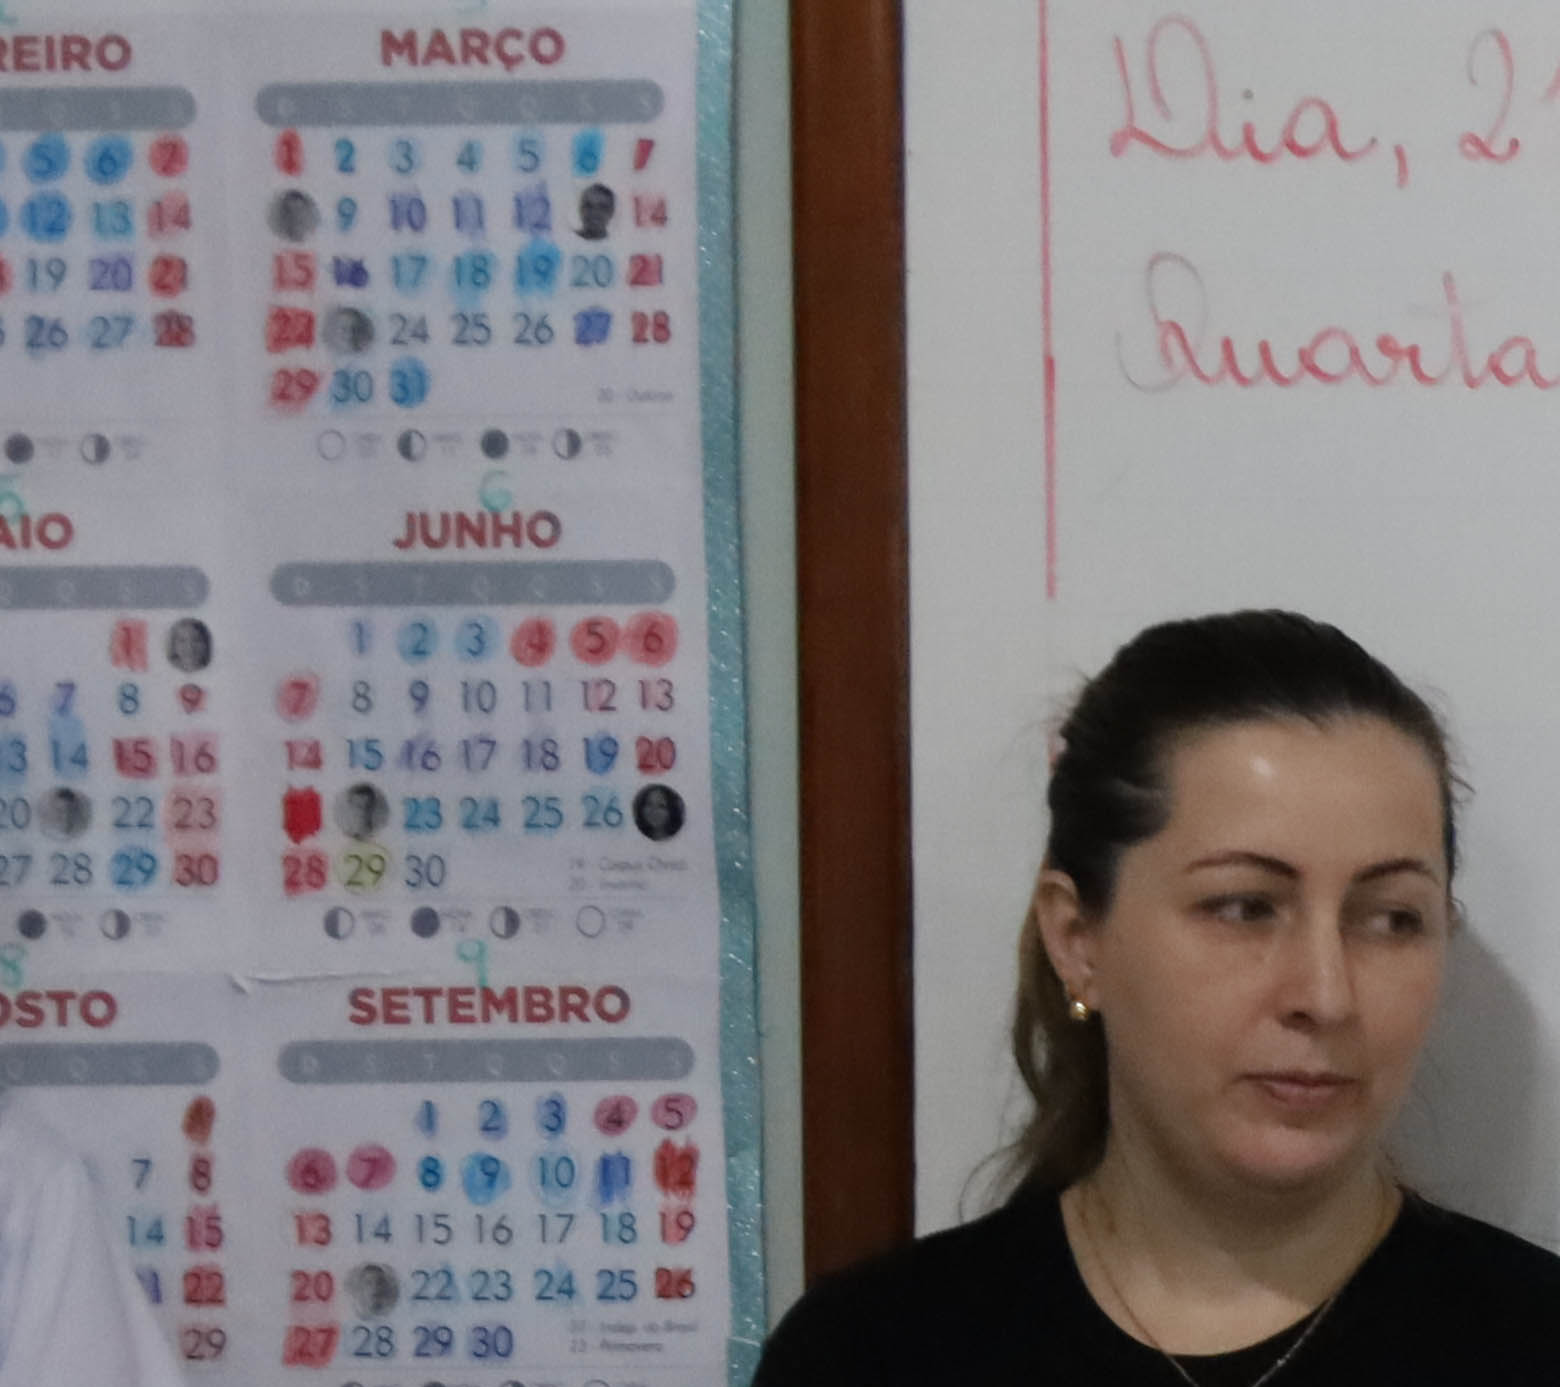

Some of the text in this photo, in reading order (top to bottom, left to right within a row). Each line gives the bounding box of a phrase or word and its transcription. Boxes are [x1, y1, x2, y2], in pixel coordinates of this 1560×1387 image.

[0, 34, 133, 72] EIRO
[380, 28, 566, 70] MARÇO
[1110, 13, 1408, 187] Dia,
[390, 312, 555, 346] 24 25 26
[393, 510, 562, 549] JUNHO
[354, 621, 486, 657] 1 2 3
[352, 678, 675, 713] 8 9 10 11 12 13
[346, 737, 560, 772] 15 16 17 18
[522, 795, 624, 830] 25 26
[343, 854, 447, 889] 29 30
[456, 938, 488, 988] 9
[348, 985, 632, 1027] SETEMBRO
[424, 1099, 564, 1132] 1 2 3
[537, 1155, 576, 1188] 10
[354, 1210, 696, 1246] 14 15 16 17 18 19
[410, 1269, 639, 1301] 22 23 24 25
[352, 1325, 514, 1358] 28 29 30
